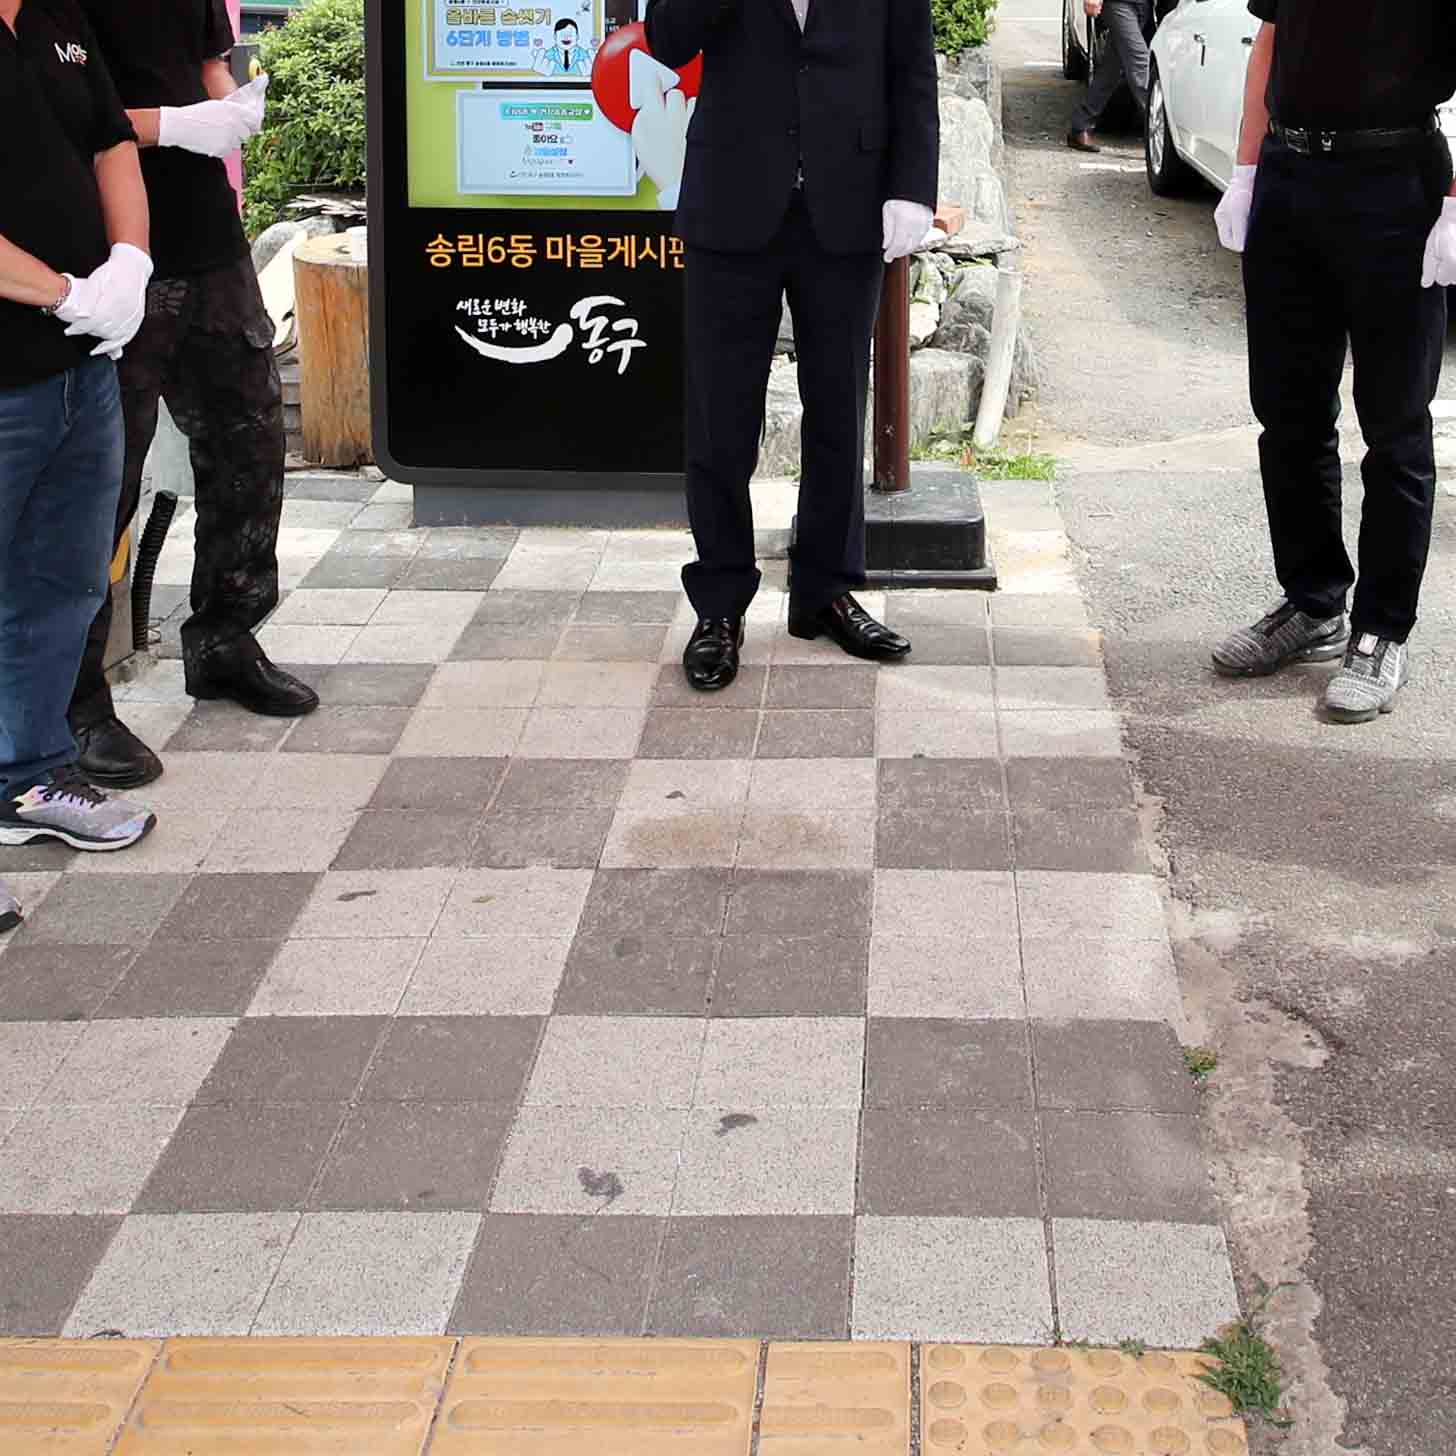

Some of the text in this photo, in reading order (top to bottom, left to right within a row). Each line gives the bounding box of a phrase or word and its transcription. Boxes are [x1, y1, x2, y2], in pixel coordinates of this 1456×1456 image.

[425, 233, 538, 269] 송림6동
[455, 297, 528, 317] 새로운 변화
[477, 317, 552, 340] 모두가 행복한
[569, 295, 648, 375] 동구
